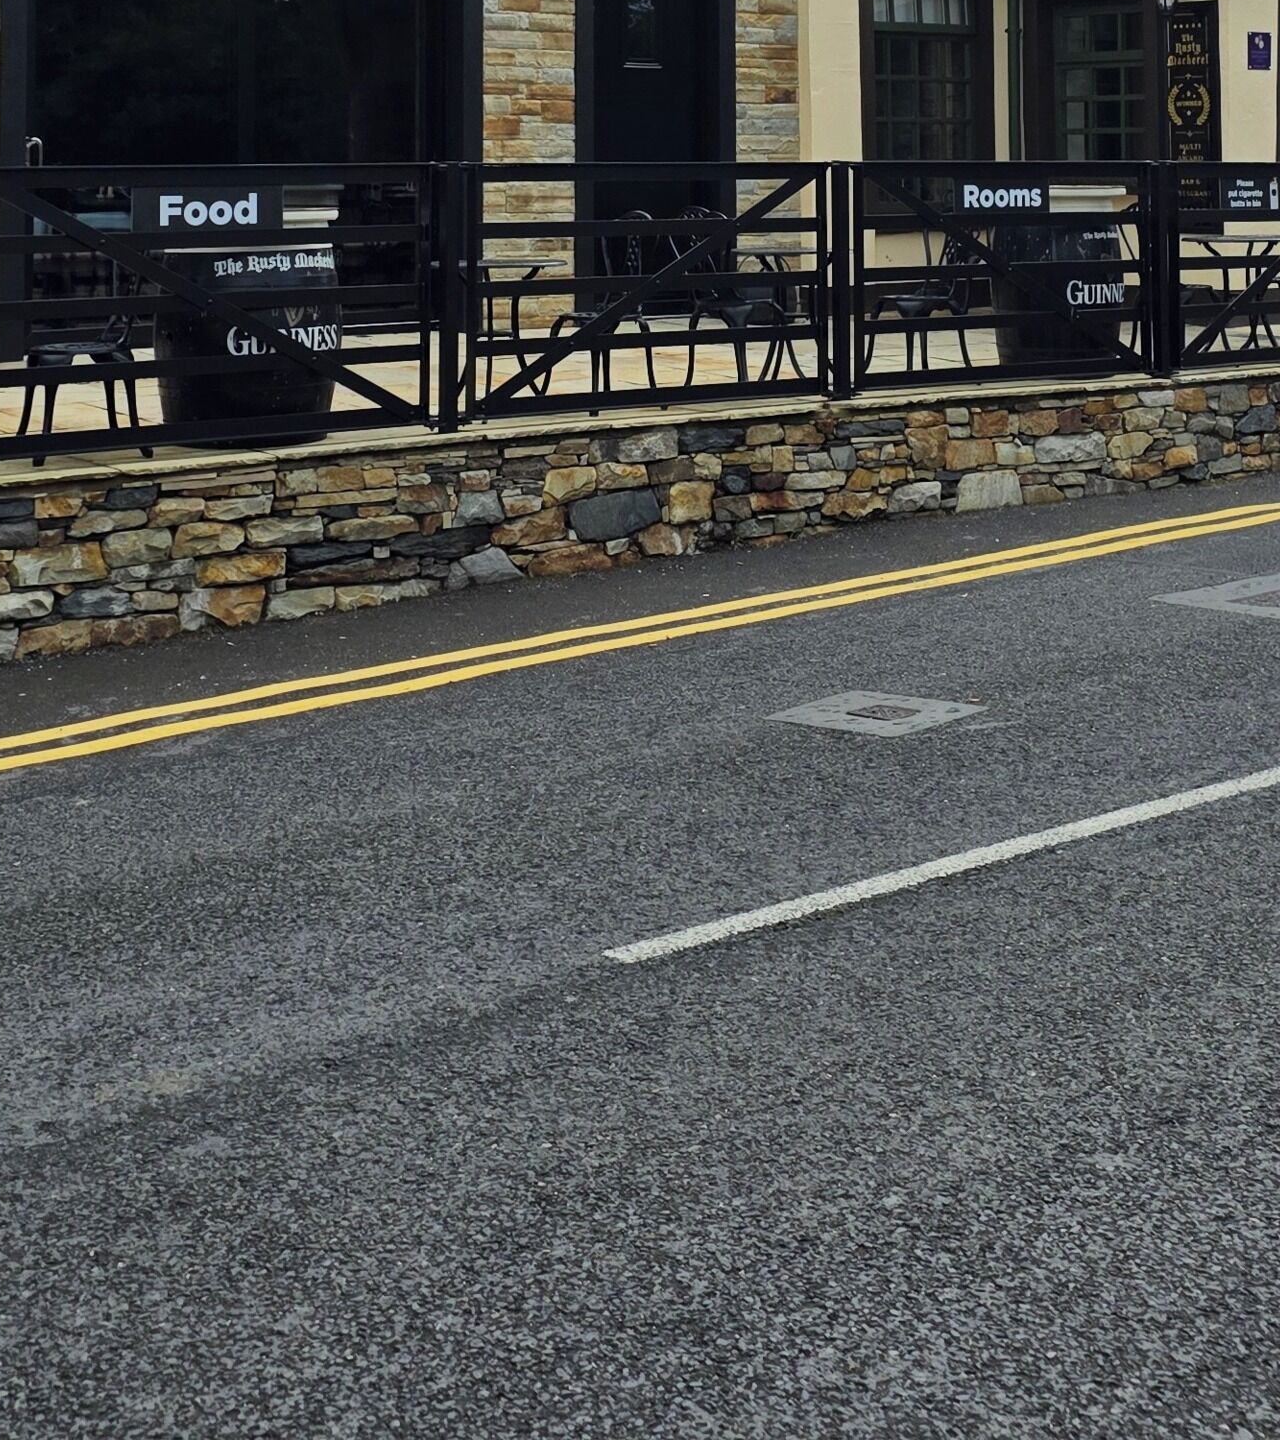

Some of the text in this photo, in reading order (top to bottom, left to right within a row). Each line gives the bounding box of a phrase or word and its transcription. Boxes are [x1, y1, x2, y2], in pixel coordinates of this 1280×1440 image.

[963, 184, 1042, 208] Rooms
[159, 193, 258, 227] Food
[214, 258, 243, 277] The
[246, 253, 291, 273] Rusty
[1066, 279, 1125, 305] GUINNE
